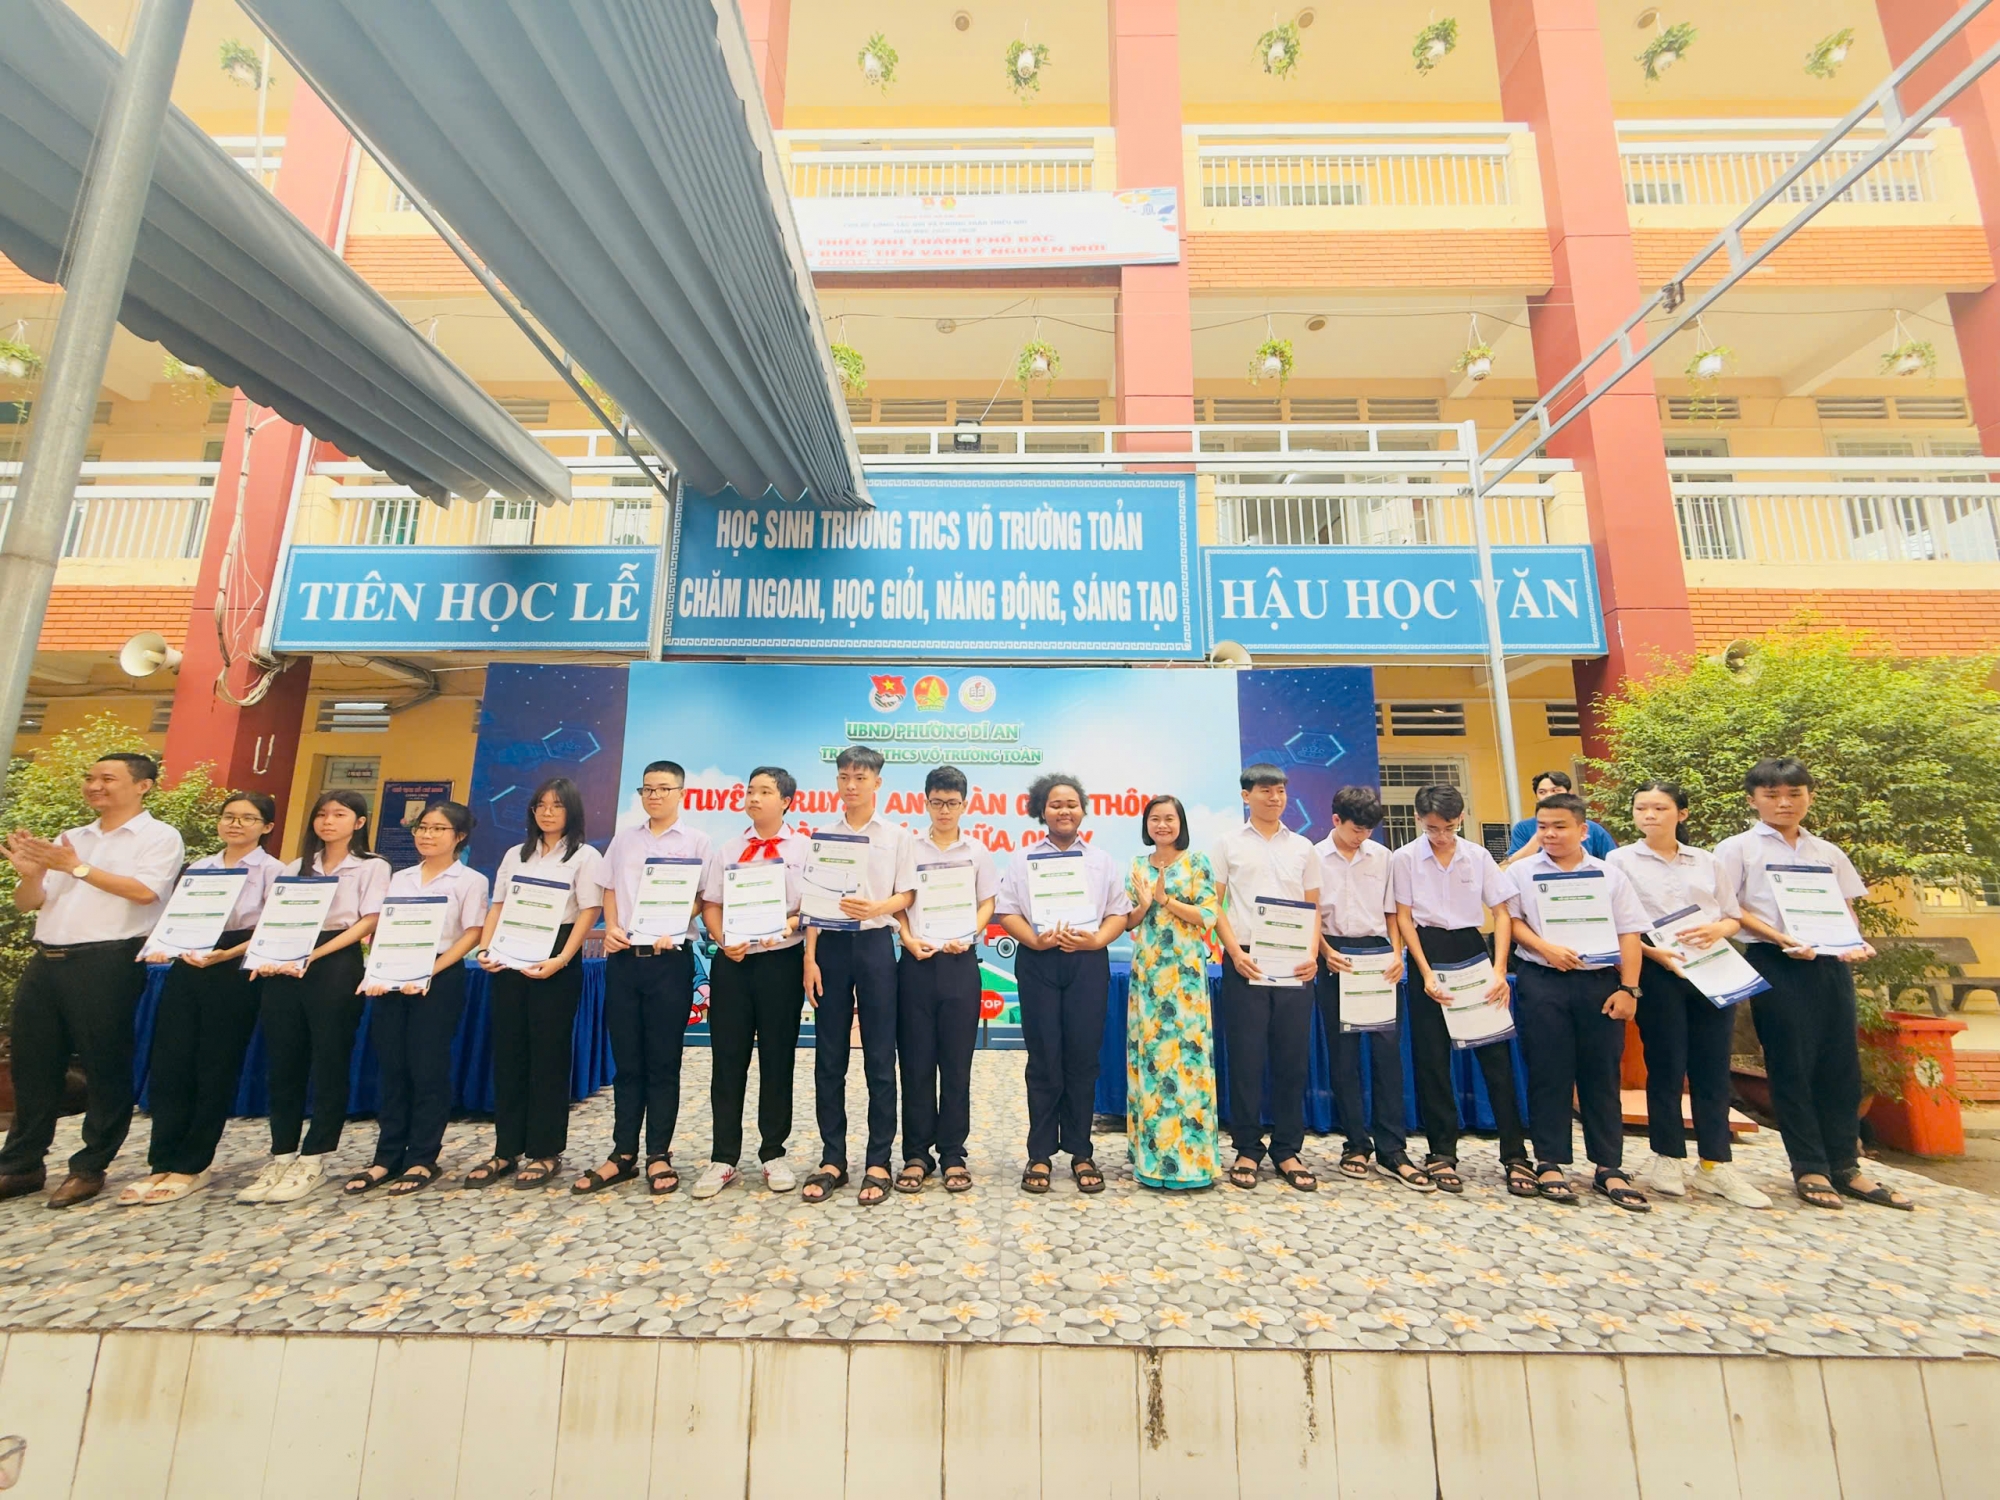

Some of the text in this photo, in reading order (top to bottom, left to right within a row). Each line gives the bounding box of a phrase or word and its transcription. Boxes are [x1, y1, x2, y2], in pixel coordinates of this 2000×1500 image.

[716, 510, 759, 557] HỌC
[764, 510, 815, 549] SINH
[909, 511, 960, 550] THCS
[966, 503, 993, 550] VÕ
[999, 501, 1081, 551] TRƯỜNG
[1087, 498, 1143, 551] TOẢN
[299, 562, 640, 633] TIÊN HỌC LỄ
[678, 566, 1178, 632] CHĂM NGOAN, HỌC GIỎI, NĂNG ĐỘNG, SÁNG TẠO
[1219, 566, 1330, 632] HẬU
[1343, 578, 1458, 632] HỌC
[846, 723, 892, 738] UBND
[896, 720, 967, 738] PHƯỜNG
[991, 724, 1018, 739] AN
[884, 748, 917, 760] THCS
[884, 792, 924, 814] AN
